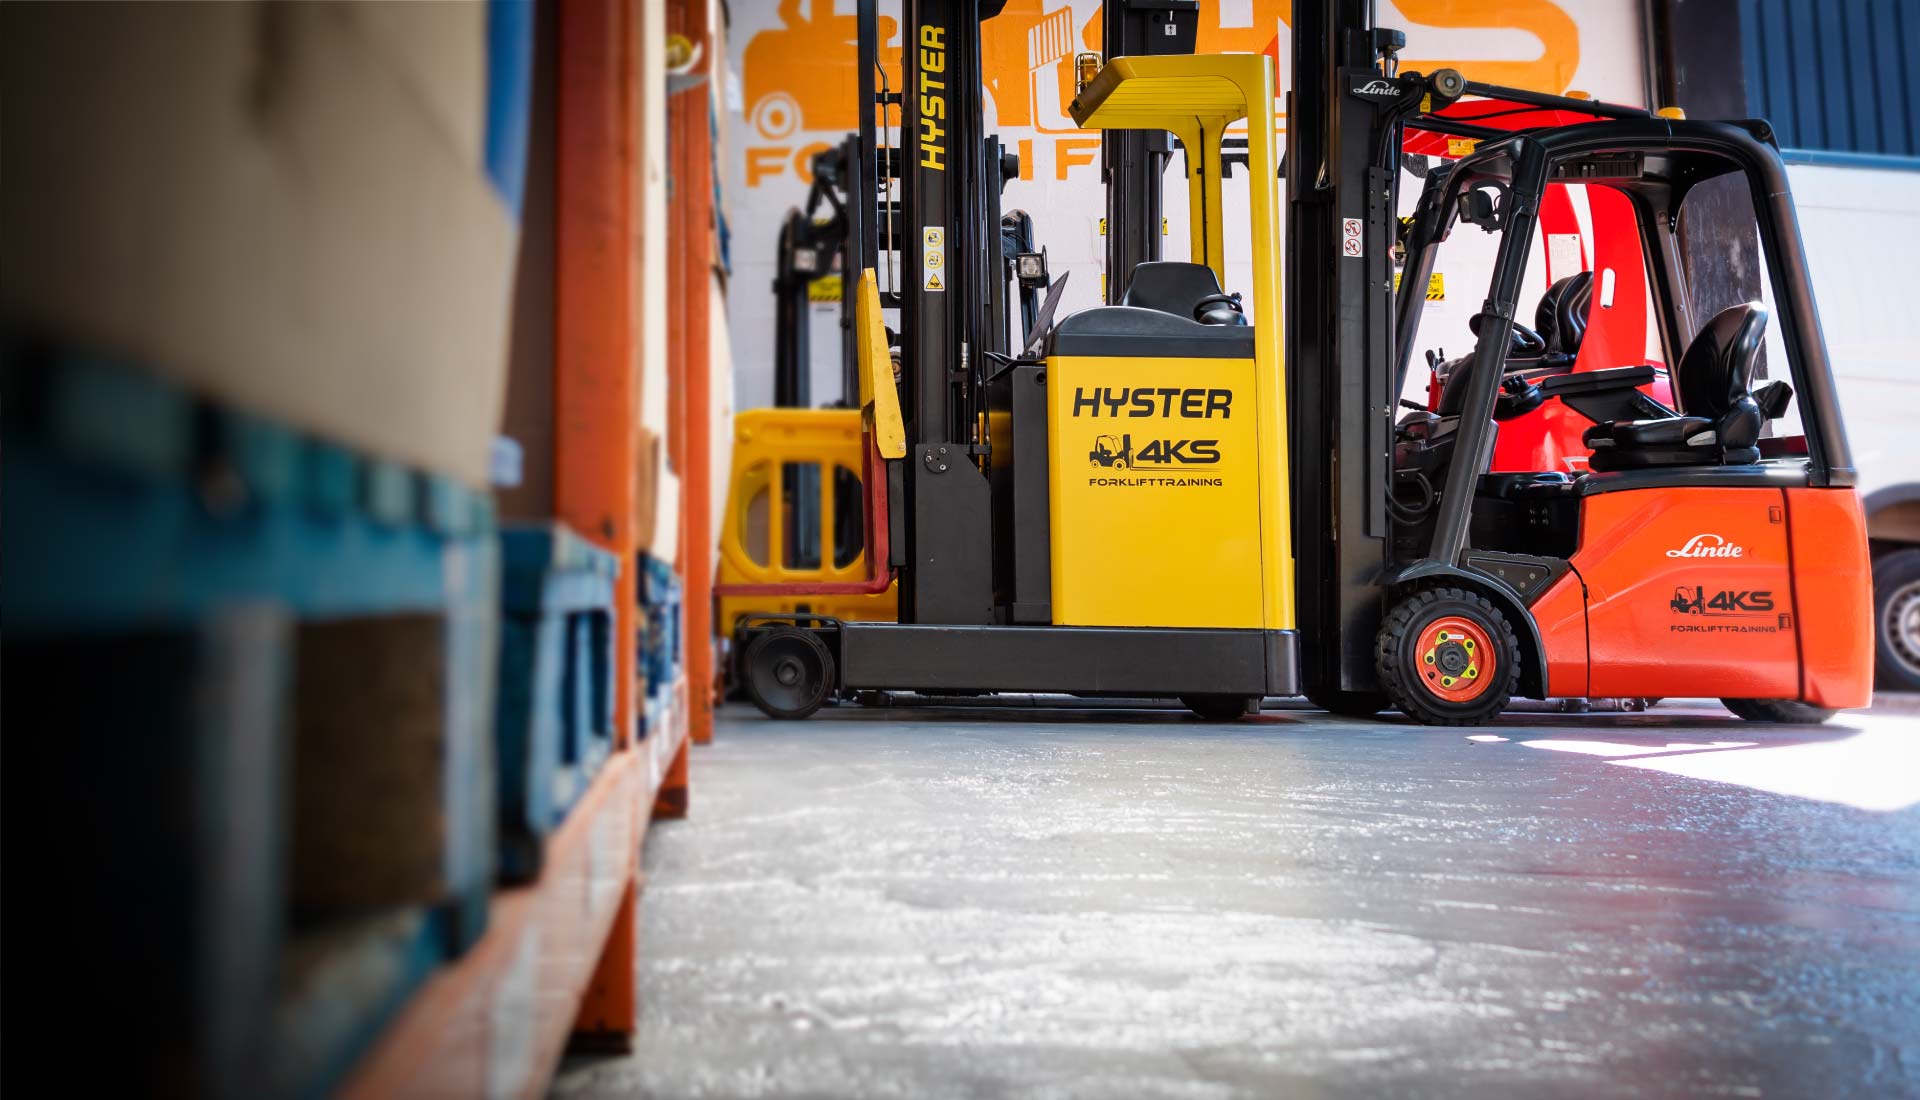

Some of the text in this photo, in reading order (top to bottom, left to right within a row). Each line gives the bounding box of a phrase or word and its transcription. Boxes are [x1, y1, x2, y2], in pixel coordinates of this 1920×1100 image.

[920, 24, 945, 171] HYSTER
[1353, 80, 1401, 96] Linde
[1072, 387, 1233, 419] HYSTER
[1136, 439, 1221, 464] 4KS
[1665, 533, 1743, 558] Linde
[1707, 590, 1774, 611] 4KS
